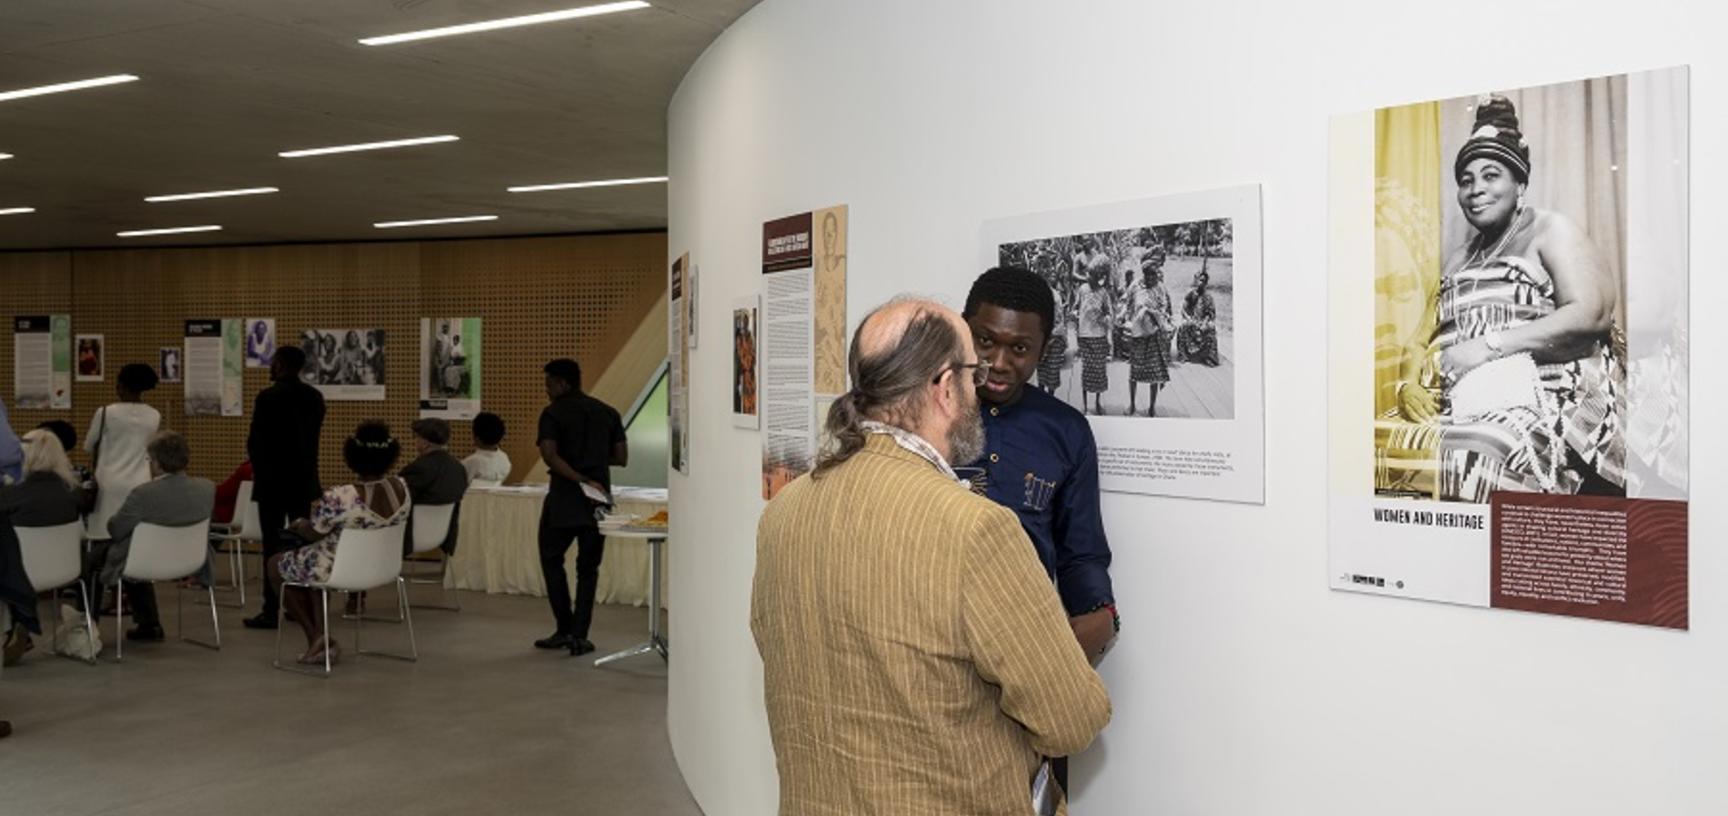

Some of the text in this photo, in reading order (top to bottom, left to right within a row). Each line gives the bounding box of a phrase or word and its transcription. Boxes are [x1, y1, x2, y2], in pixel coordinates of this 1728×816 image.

[1374, 508, 1410, 524] WOMEN
[1413, 511, 1433, 526] AND
[1436, 513, 1485, 530] HERITAGE
